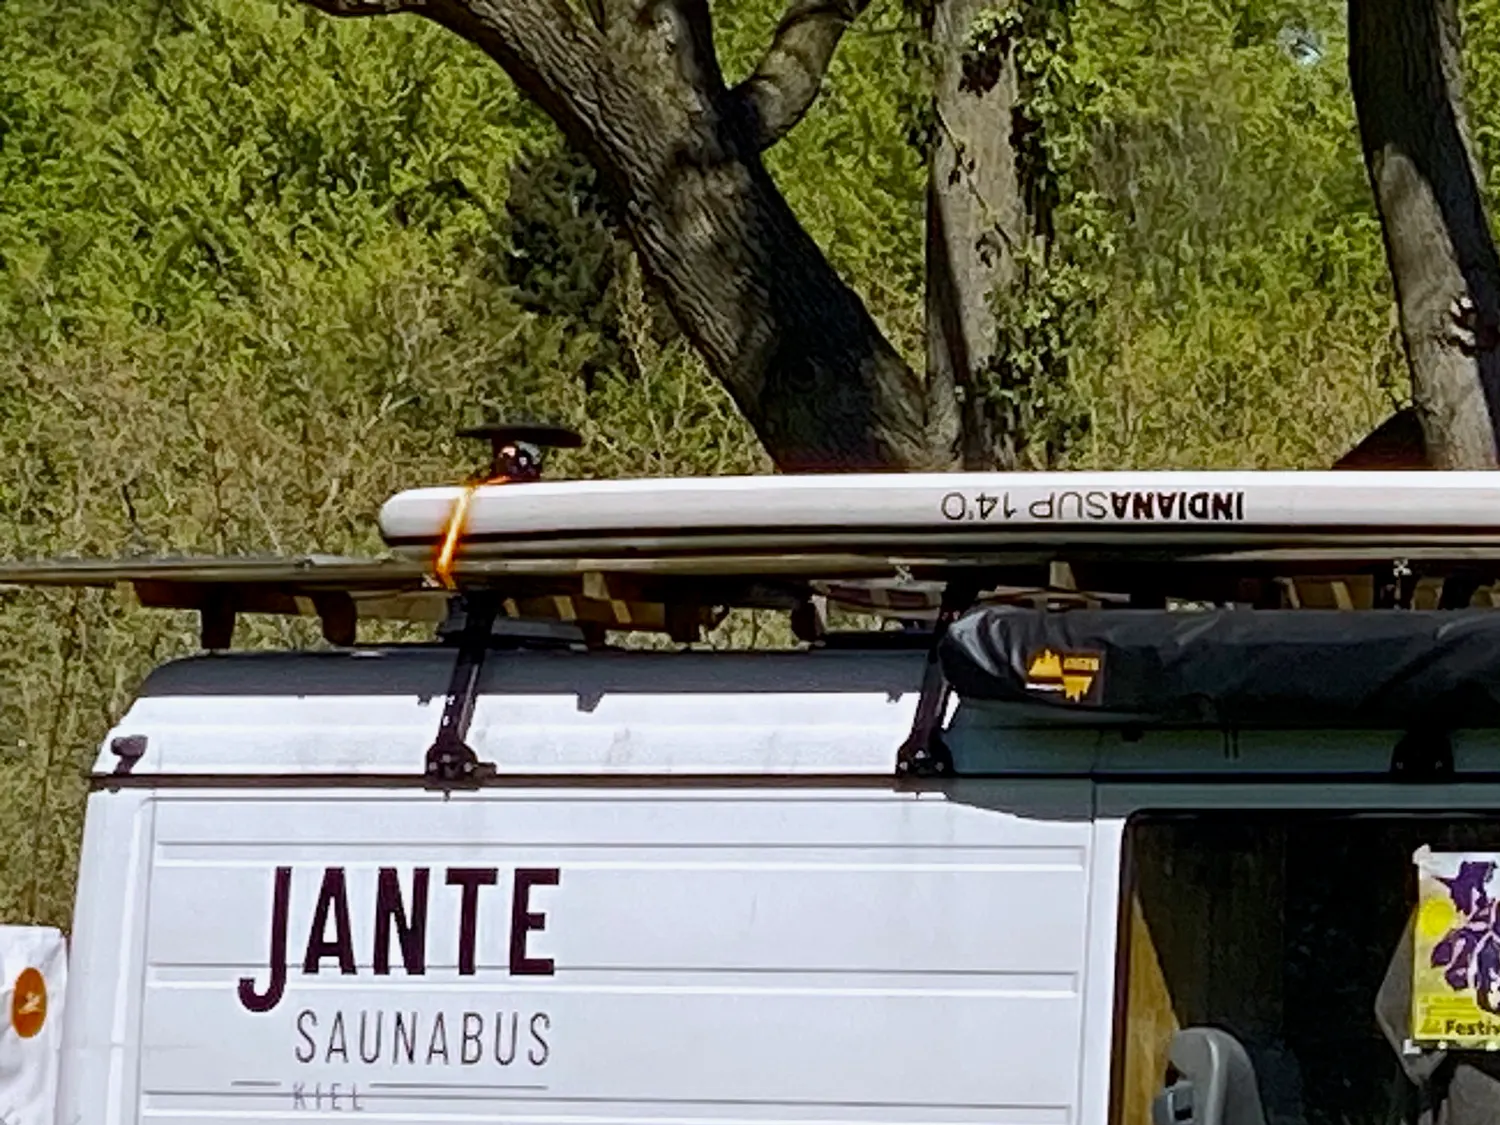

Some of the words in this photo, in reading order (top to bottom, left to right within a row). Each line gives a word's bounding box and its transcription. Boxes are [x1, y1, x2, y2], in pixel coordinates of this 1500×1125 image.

[238, 866, 561, 1012] JANTE
[295, 1009, 551, 1066] SAUNABUS
[292, 1082, 365, 1111] KIEL
